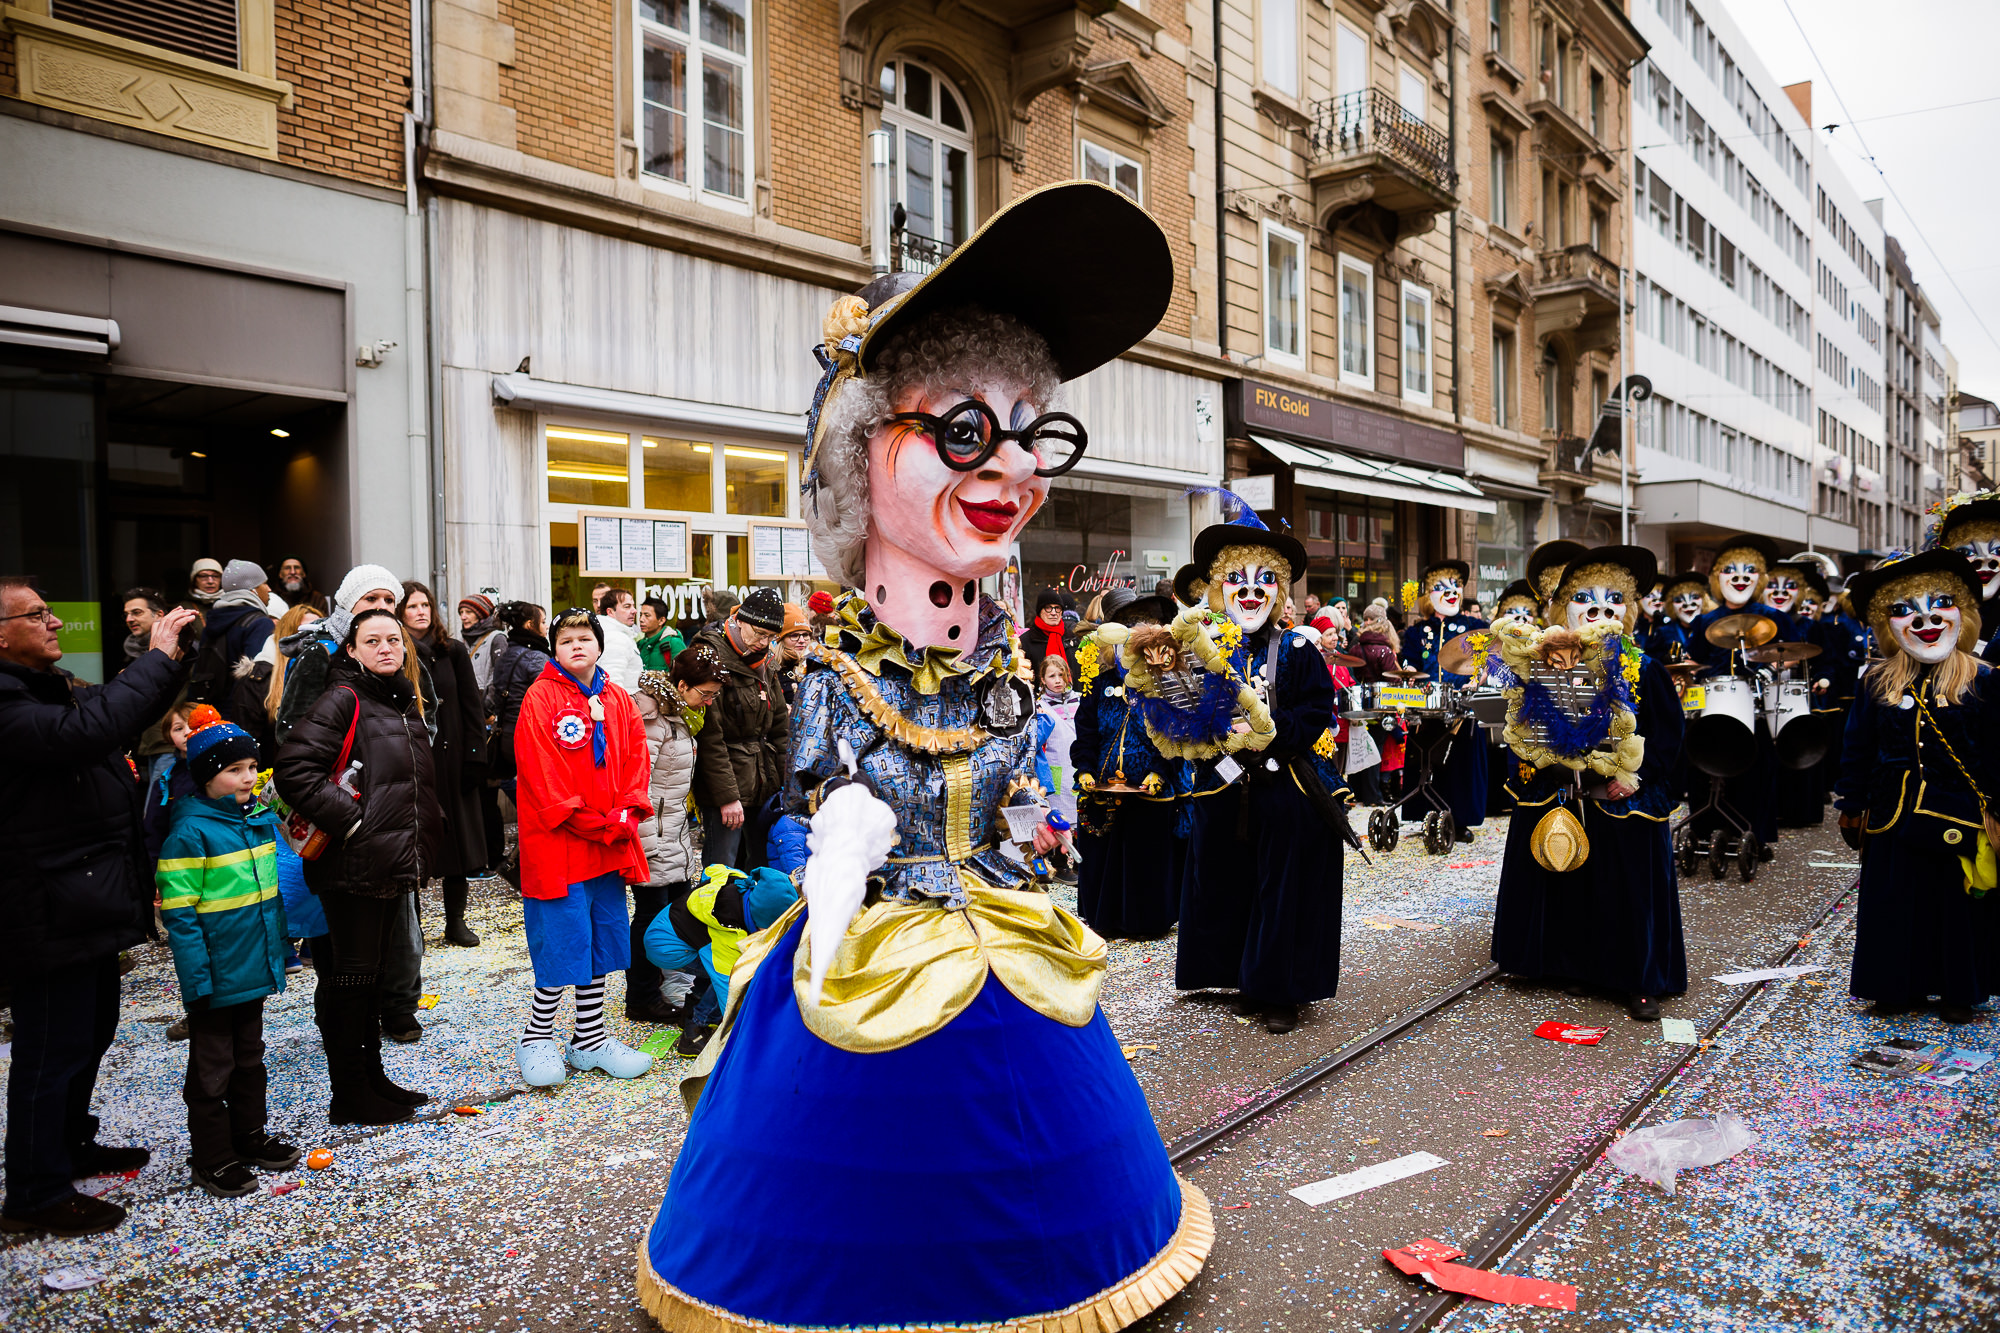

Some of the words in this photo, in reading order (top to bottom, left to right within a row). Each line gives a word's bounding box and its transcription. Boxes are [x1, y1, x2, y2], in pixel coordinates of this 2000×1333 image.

[1255, 387, 1278, 409] FIX
[1279, 395, 1310, 417] Gold
[65, 619, 95, 635] port
